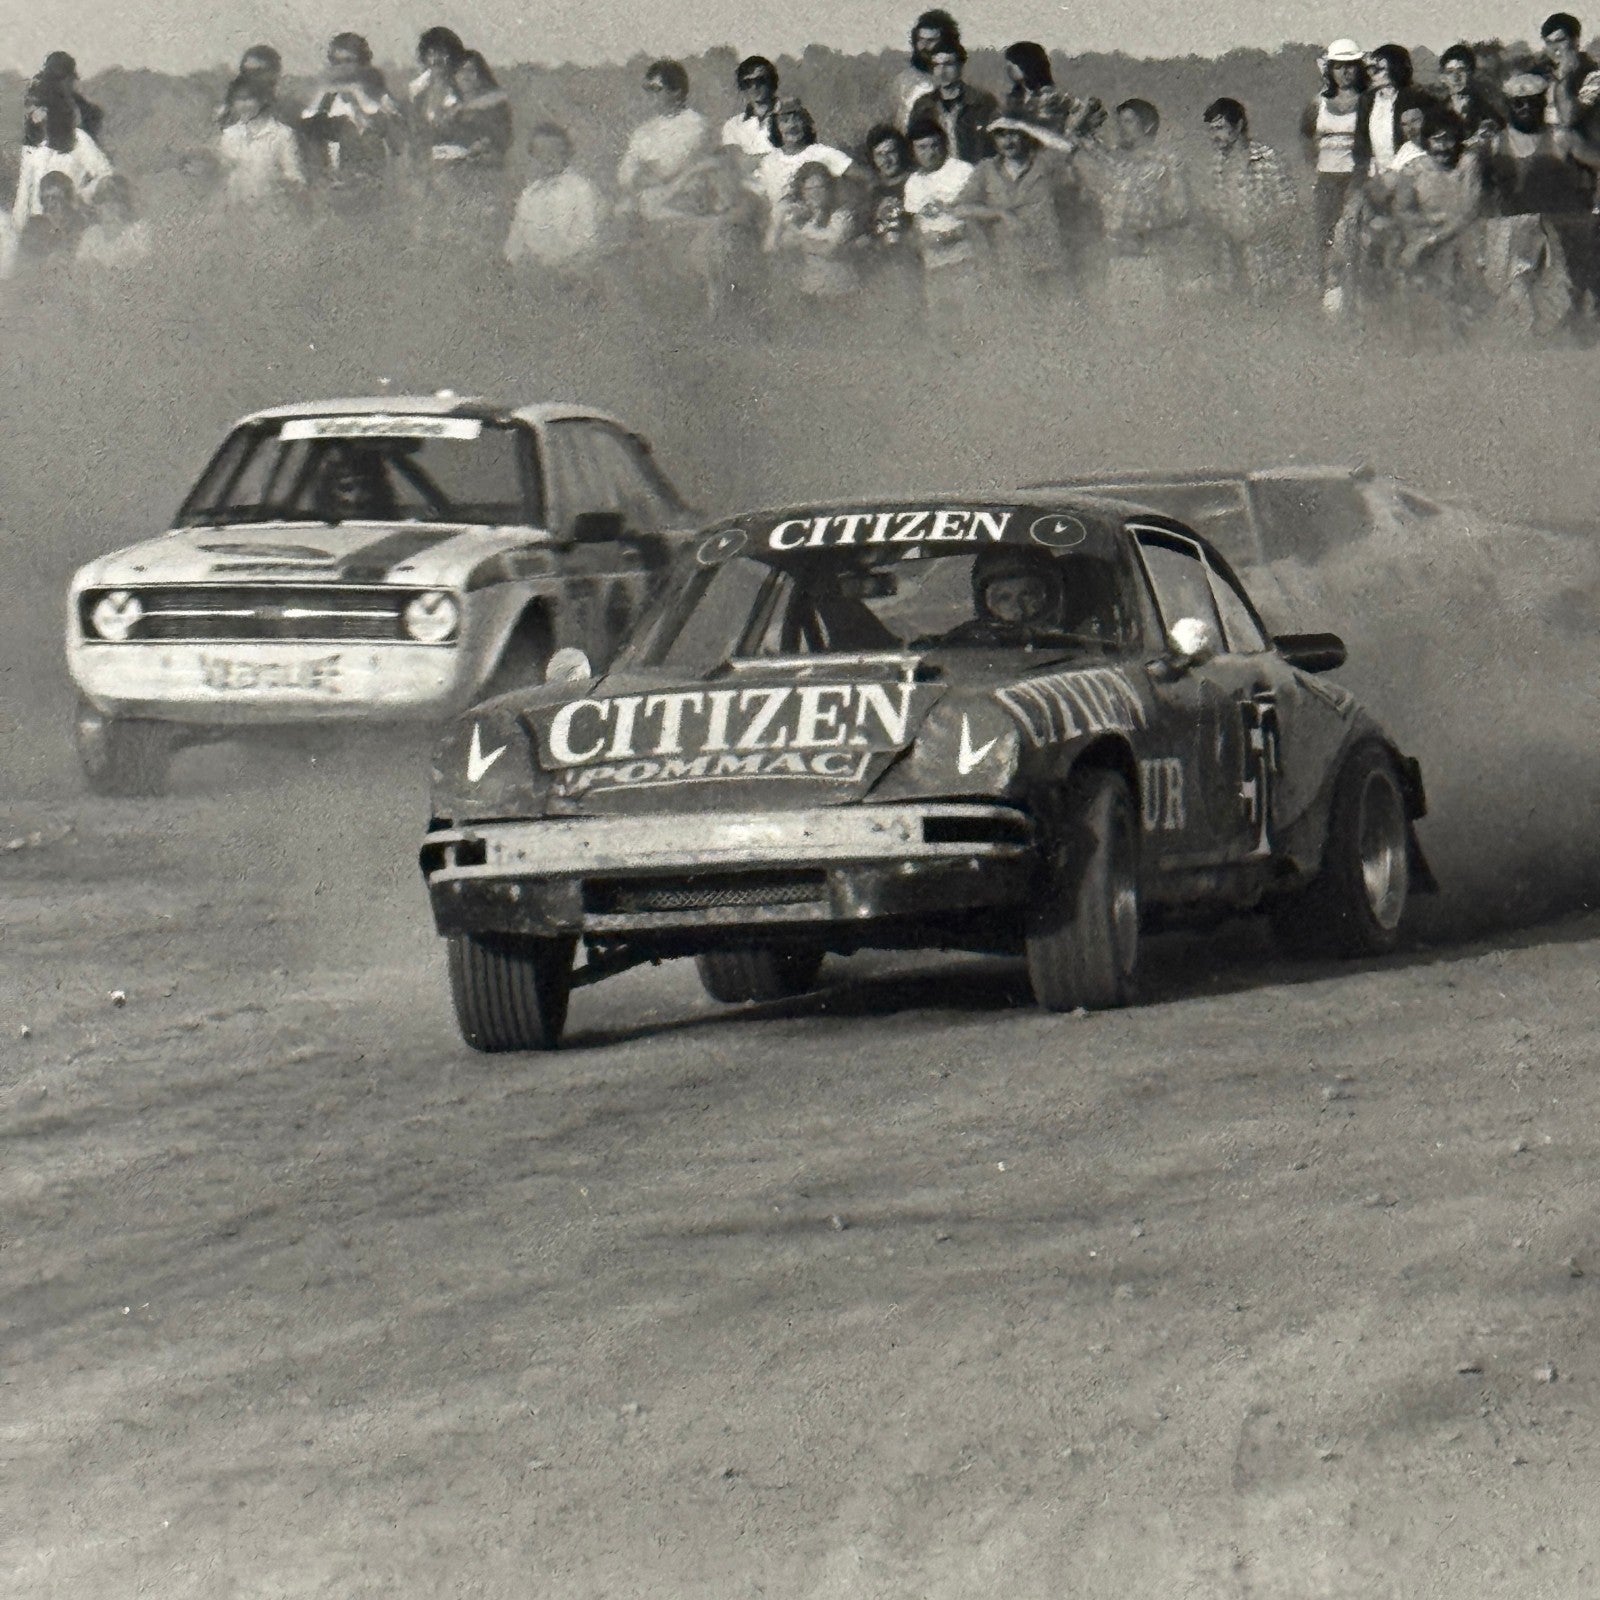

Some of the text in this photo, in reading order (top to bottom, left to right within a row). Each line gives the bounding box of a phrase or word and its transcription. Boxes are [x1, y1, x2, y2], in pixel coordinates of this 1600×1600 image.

[769, 510, 1012, 550] CITIZEN
[549, 682, 915, 763] CITIZEN
[568, 752, 853, 796] POMMAC
